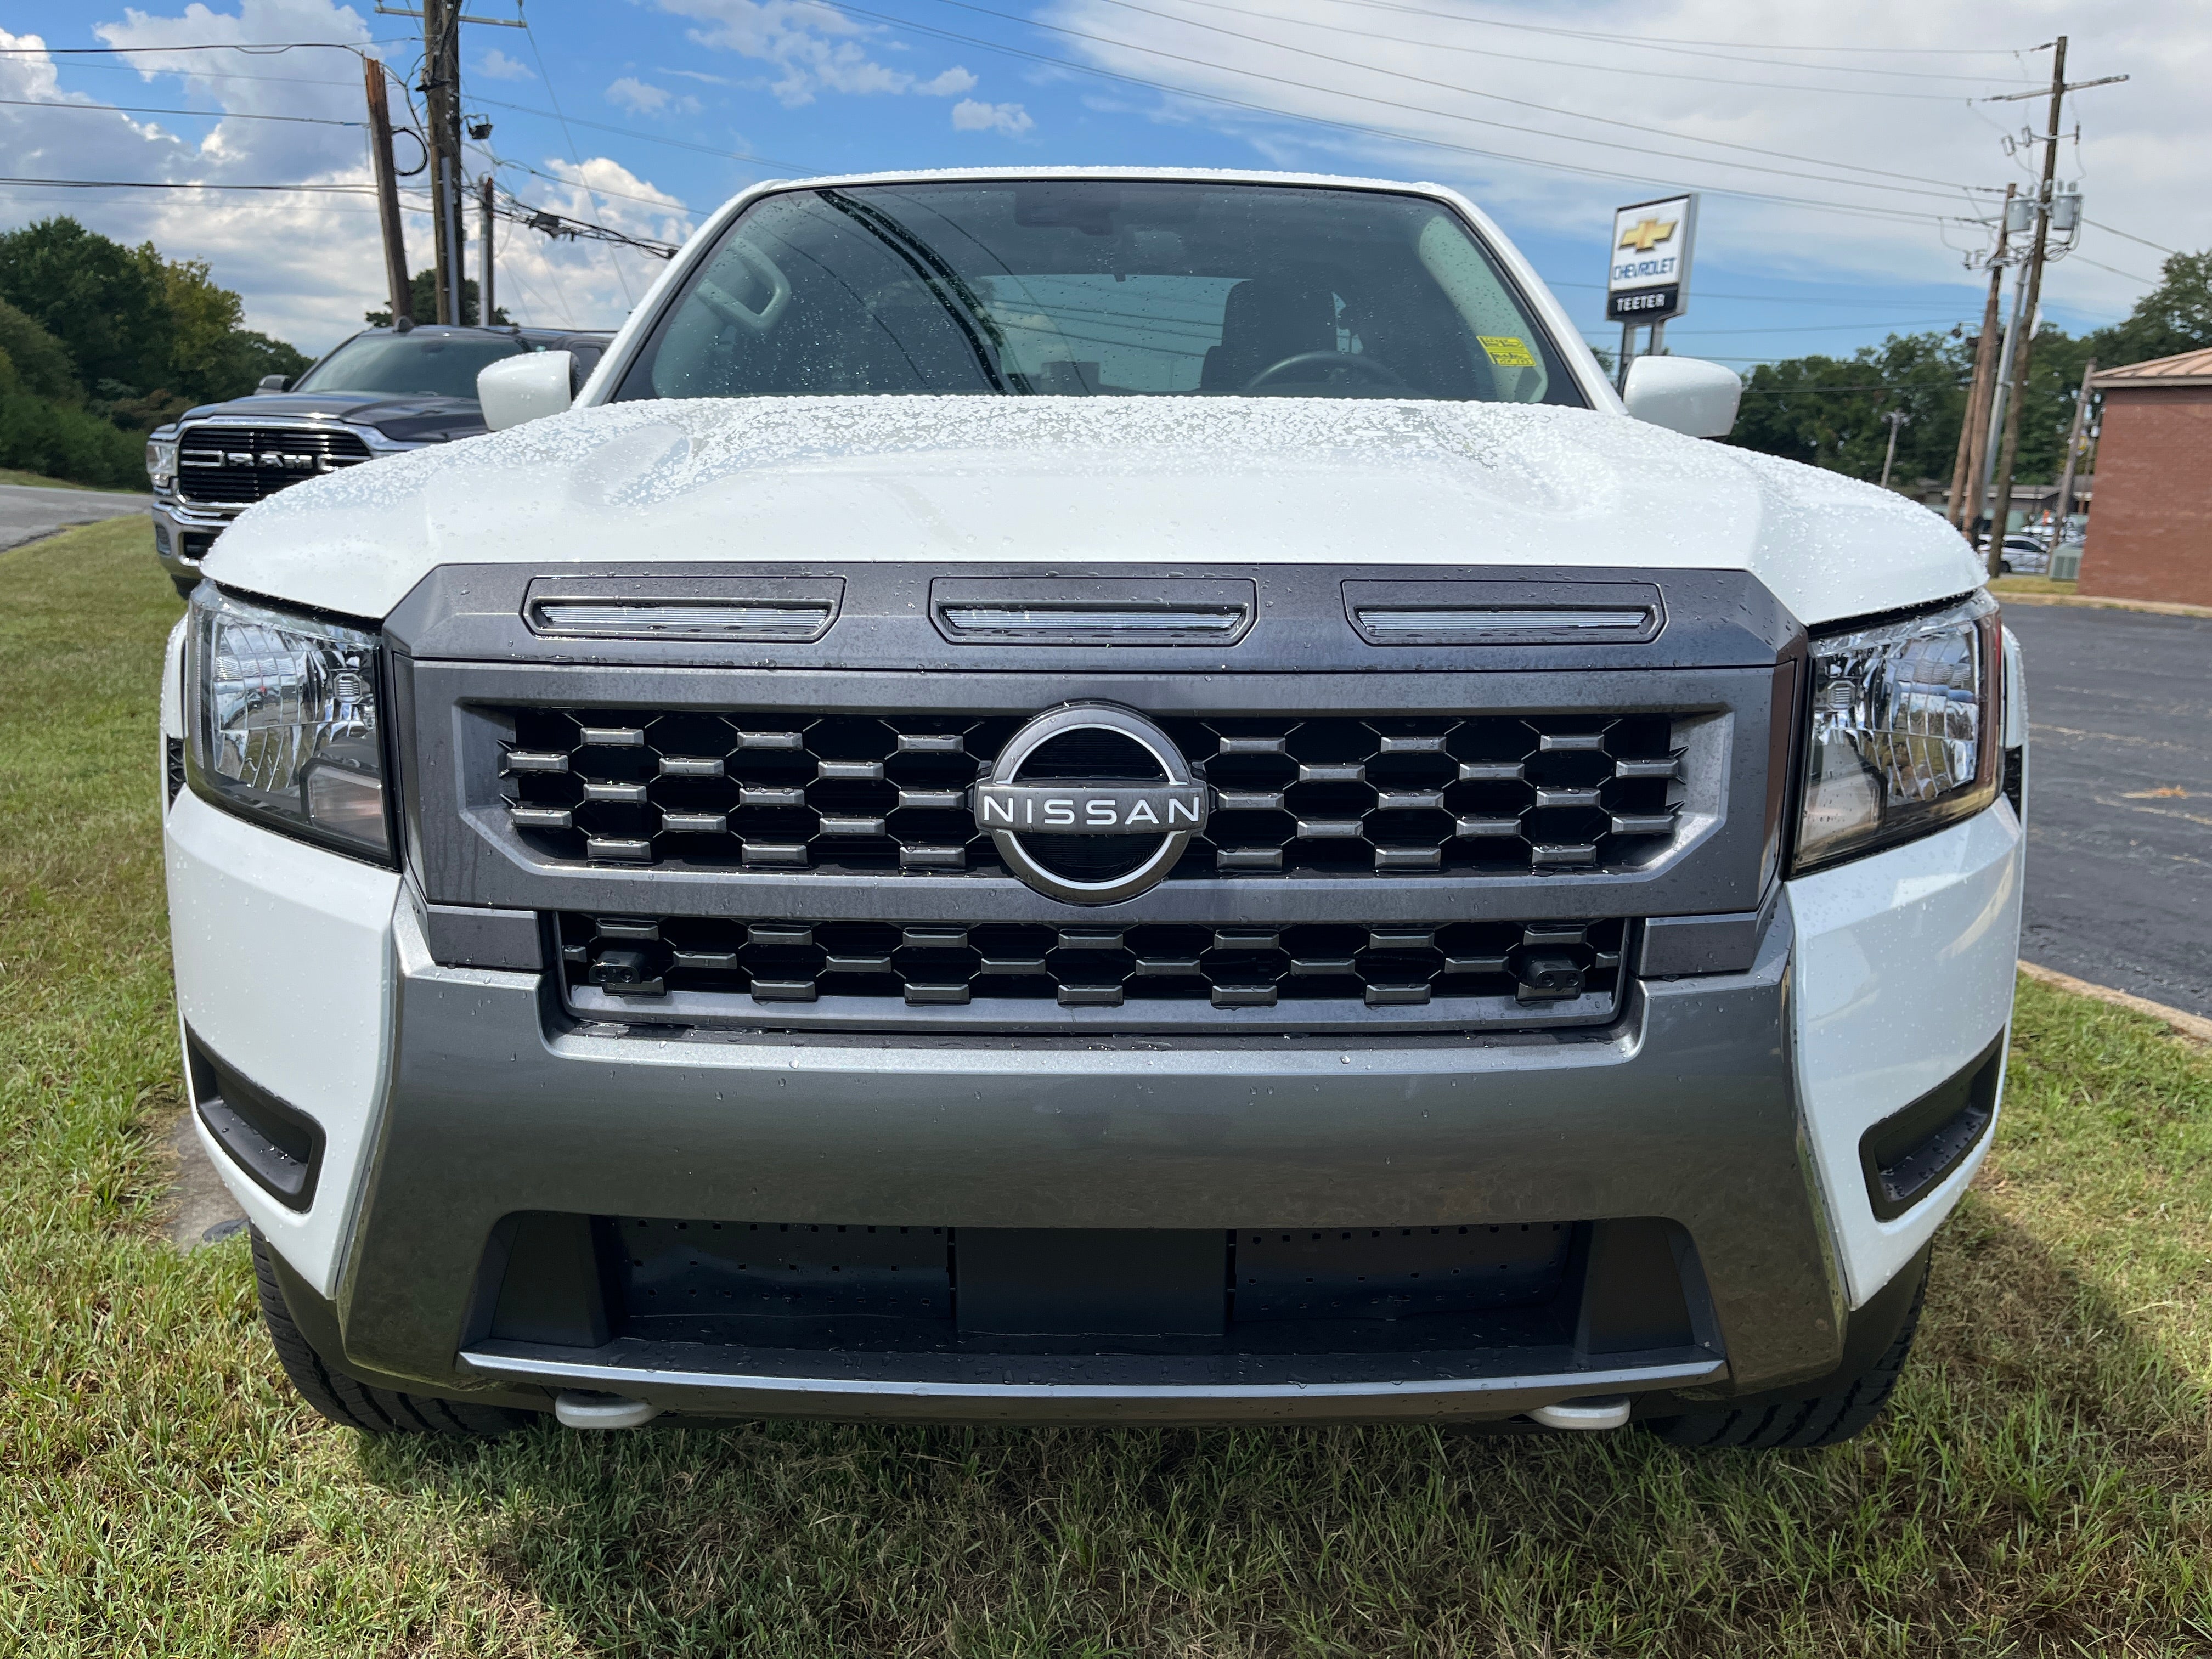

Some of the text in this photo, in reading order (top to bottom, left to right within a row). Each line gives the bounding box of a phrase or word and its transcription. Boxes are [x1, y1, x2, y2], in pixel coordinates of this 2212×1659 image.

[1613, 257, 1676, 280] CHEVROLET
[1616, 293, 1666, 312] TEETER
[227, 452, 313, 468] RAM
[984, 795, 1199, 825] NISSAN
